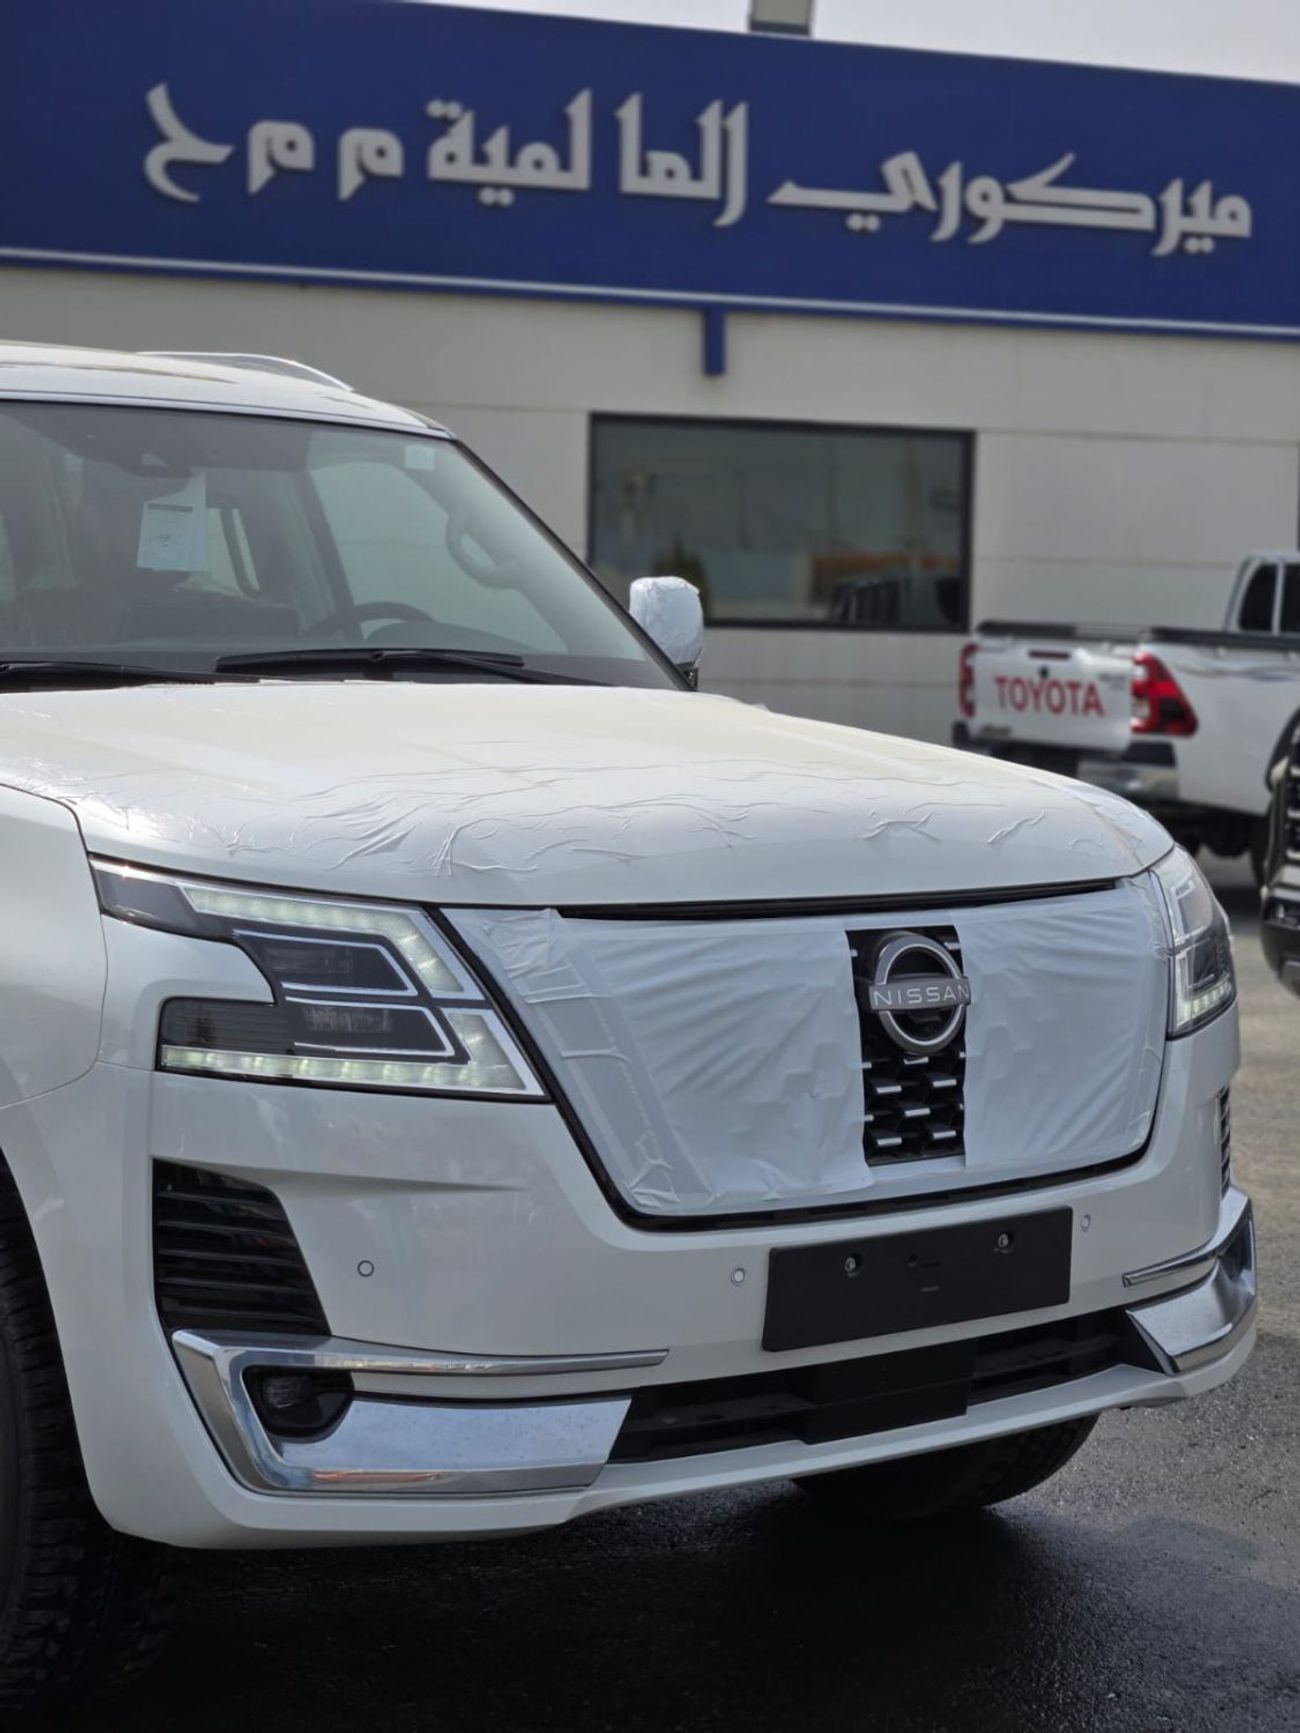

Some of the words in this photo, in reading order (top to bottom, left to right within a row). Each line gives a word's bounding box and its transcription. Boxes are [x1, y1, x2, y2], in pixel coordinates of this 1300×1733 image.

[144, 83, 234, 202] ح
[248, 120, 315, 194] م
[339, 128, 404, 200] م
[426, 88, 748, 227] العالمية
[767, 152, 1253, 256] ميركوري
[994, 675, 1106, 718] TOYOTA
[872, 984, 970, 1007] NISSAN
